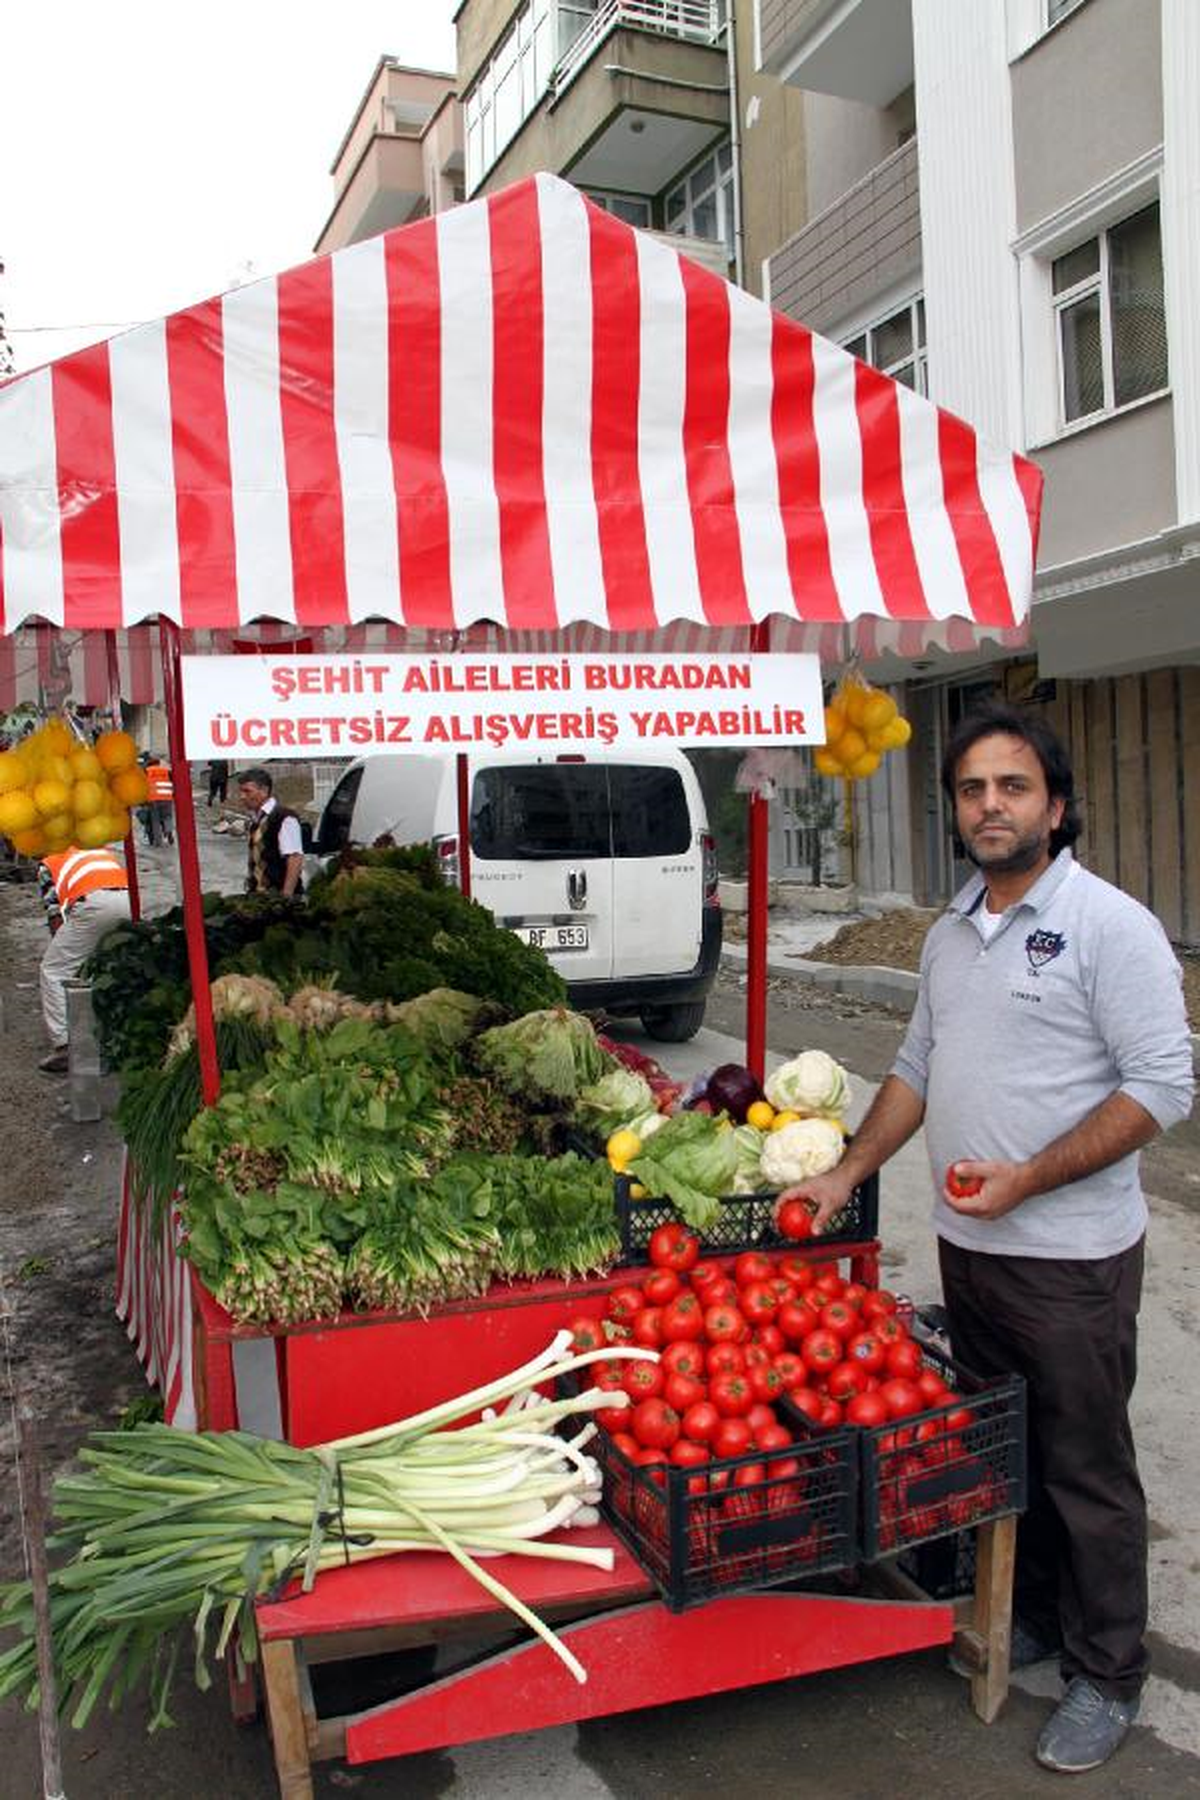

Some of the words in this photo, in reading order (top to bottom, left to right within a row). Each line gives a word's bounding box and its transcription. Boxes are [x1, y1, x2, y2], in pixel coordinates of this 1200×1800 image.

[271, 660, 390, 701] ŞEHİT
[402, 660, 570, 692] AİLELERİ
[585, 664, 751, 690] BURADAN
[210, 710, 412, 747] ÜCRETSİZ
[424, 706, 618, 747] ALIŞVERİŞ
[630, 703, 806, 737] YAPABİLİR
[529, 929, 546, 946] BF
[558, 928, 584, 945] 653
